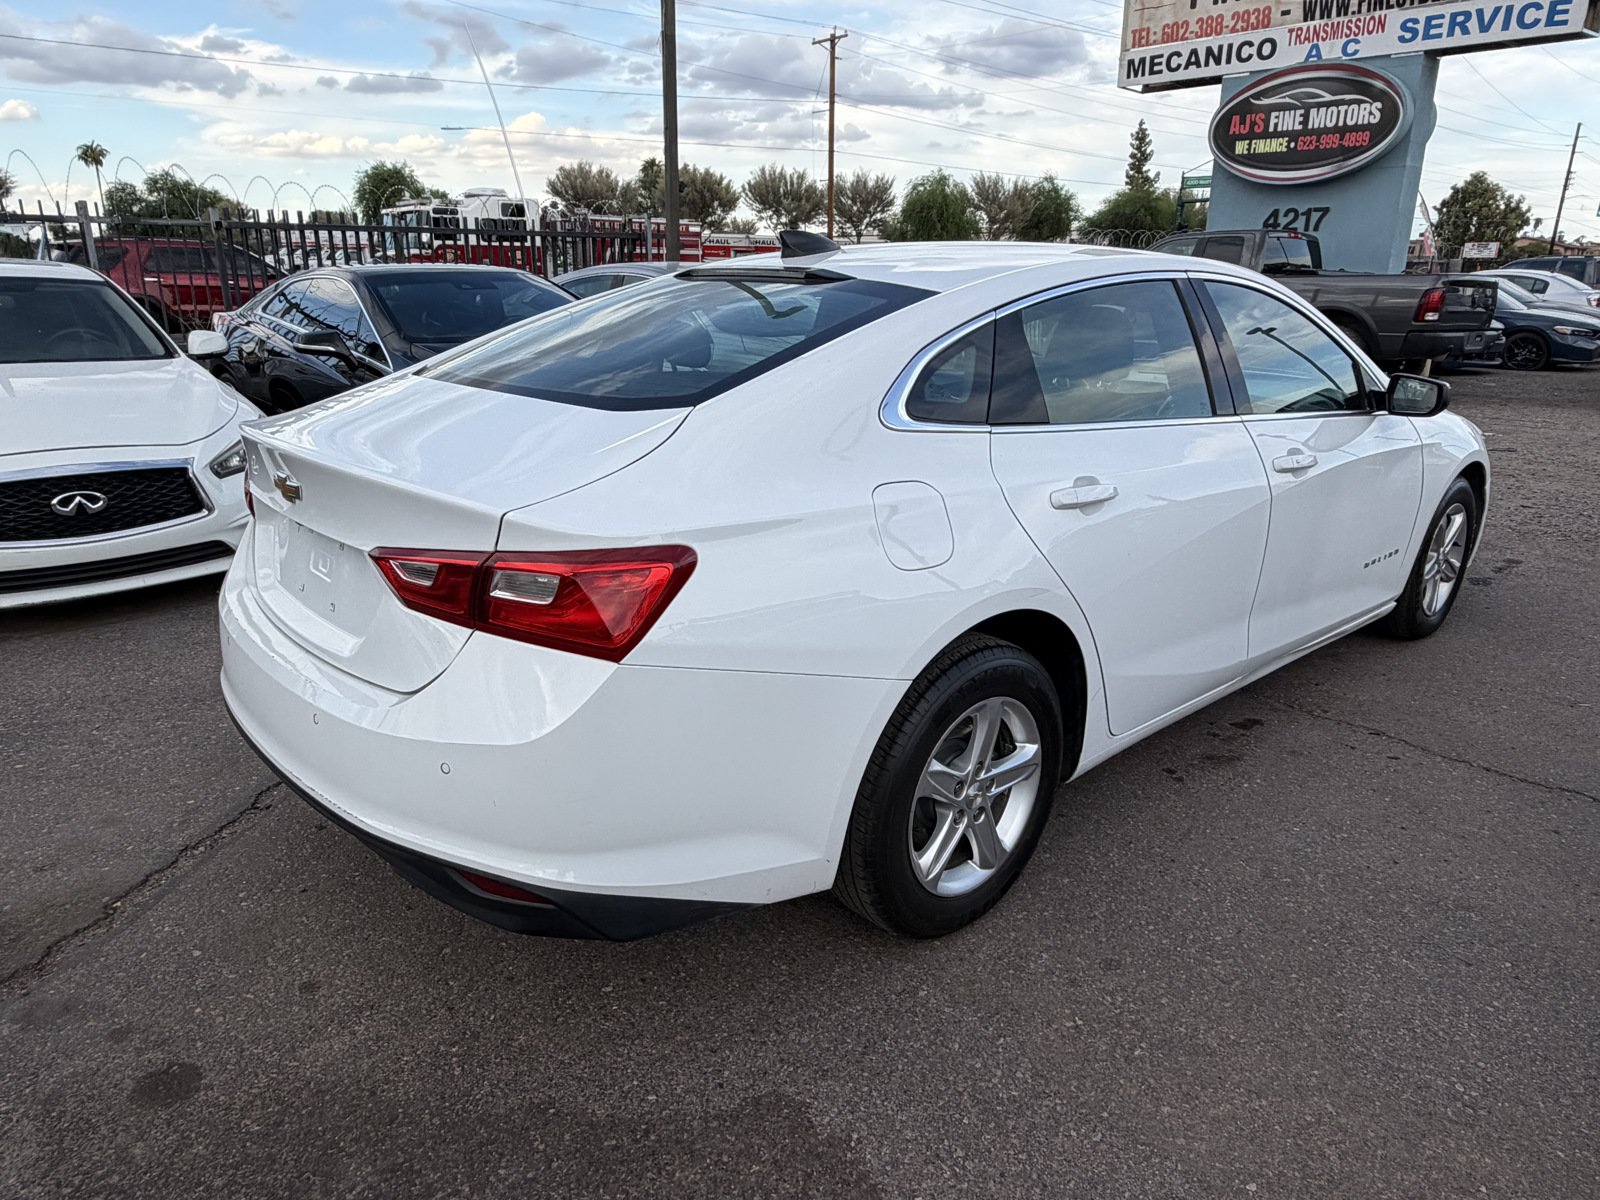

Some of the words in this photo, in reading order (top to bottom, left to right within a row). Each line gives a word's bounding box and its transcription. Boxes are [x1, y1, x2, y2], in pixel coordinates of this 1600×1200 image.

[1131, 27, 1158, 48] TEL:
[1161, 6, 1272, 44] 602-388-2938
[1287, 14, 1387, 47] TRANSMISSION
[1397, 0, 1574, 44] SERVICE
[1126, 37, 1278, 79] MECANICO
[1303, 43, 1323, 63] A
[1341, 38, 1361, 58] C
[1229, 112, 1265, 136] AJ'S
[1268, 109, 1305, 132] FINE
[1307, 101, 1383, 130] MOTORS
[1235, 140, 1249, 155] WE
[1250, 137, 1289, 154] FINANCE
[1296, 131, 1371, 151] 623-999-4899
[1262, 206, 1330, 232] 4217
